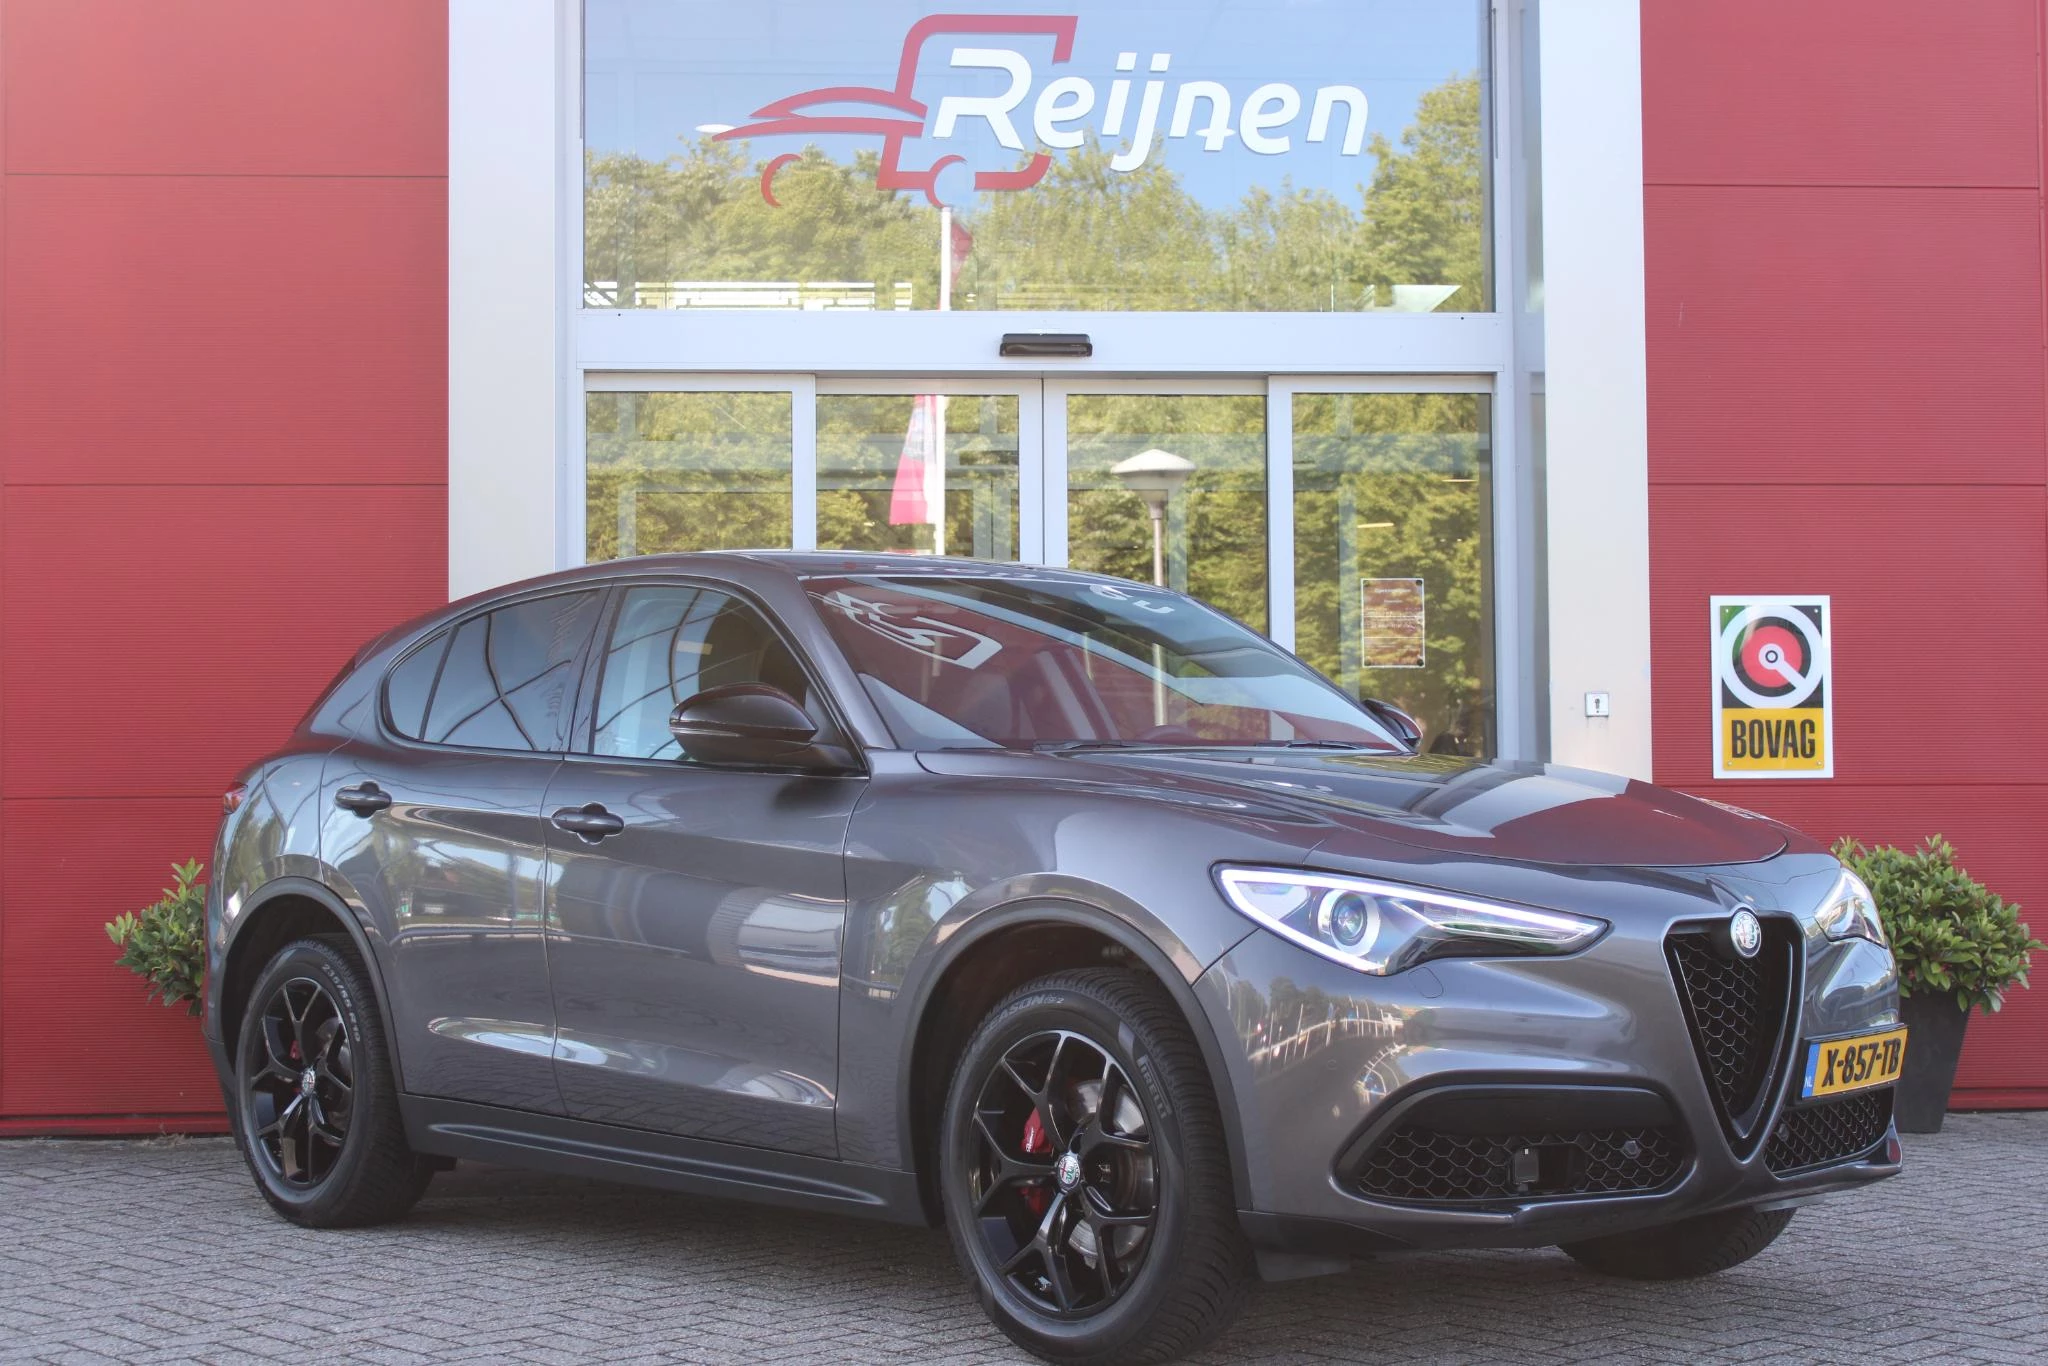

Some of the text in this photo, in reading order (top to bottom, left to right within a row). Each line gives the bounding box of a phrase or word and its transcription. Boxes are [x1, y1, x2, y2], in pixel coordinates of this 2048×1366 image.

[932, 47, 1369, 173] Reijnen
[1731, 718, 1816, 759] BOVAG
[1135, 1054, 1173, 1119] PIRELLI
[1804, 1075, 1813, 1088] NL
[1821, 1037, 1901, 1088] X-857-TB
